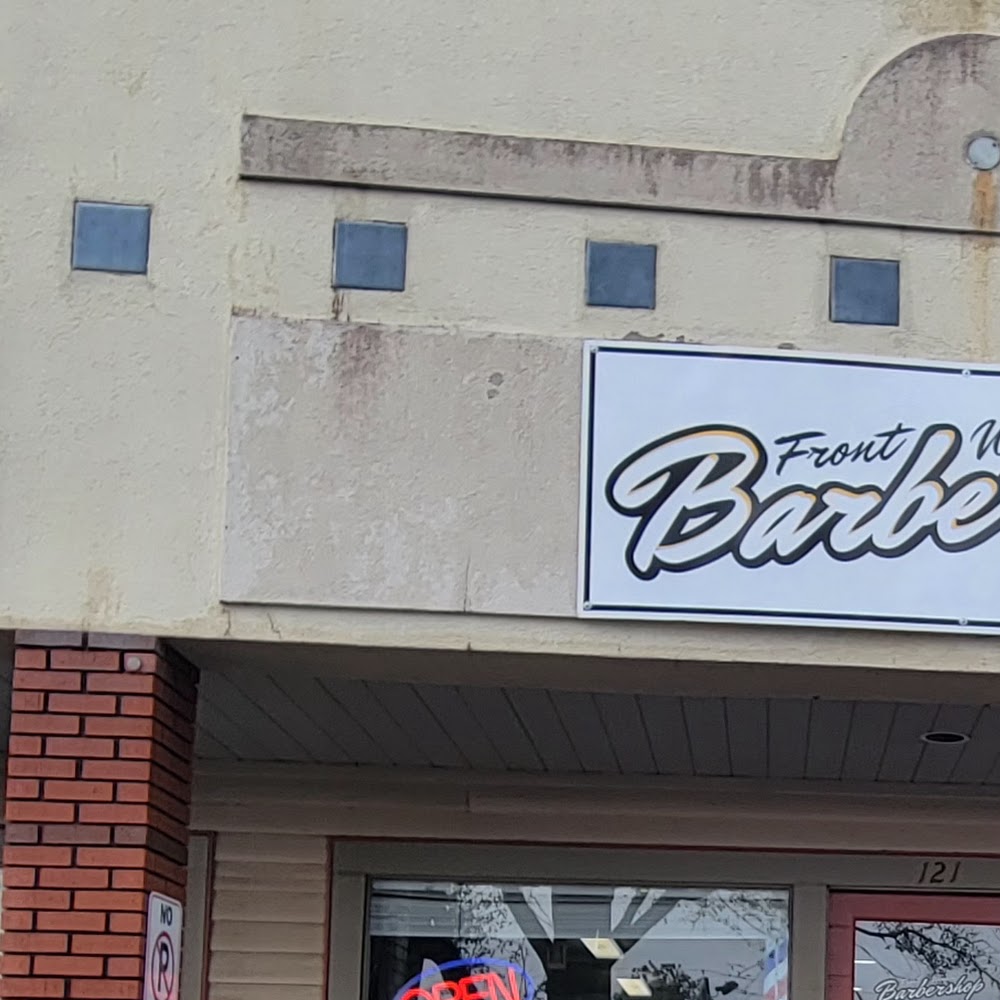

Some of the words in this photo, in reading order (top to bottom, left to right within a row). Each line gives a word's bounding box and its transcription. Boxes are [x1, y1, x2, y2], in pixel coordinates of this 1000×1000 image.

[774, 421, 915, 476] Front
[918, 861, 961, 884] 121
[160, 903, 173, 927] NO
